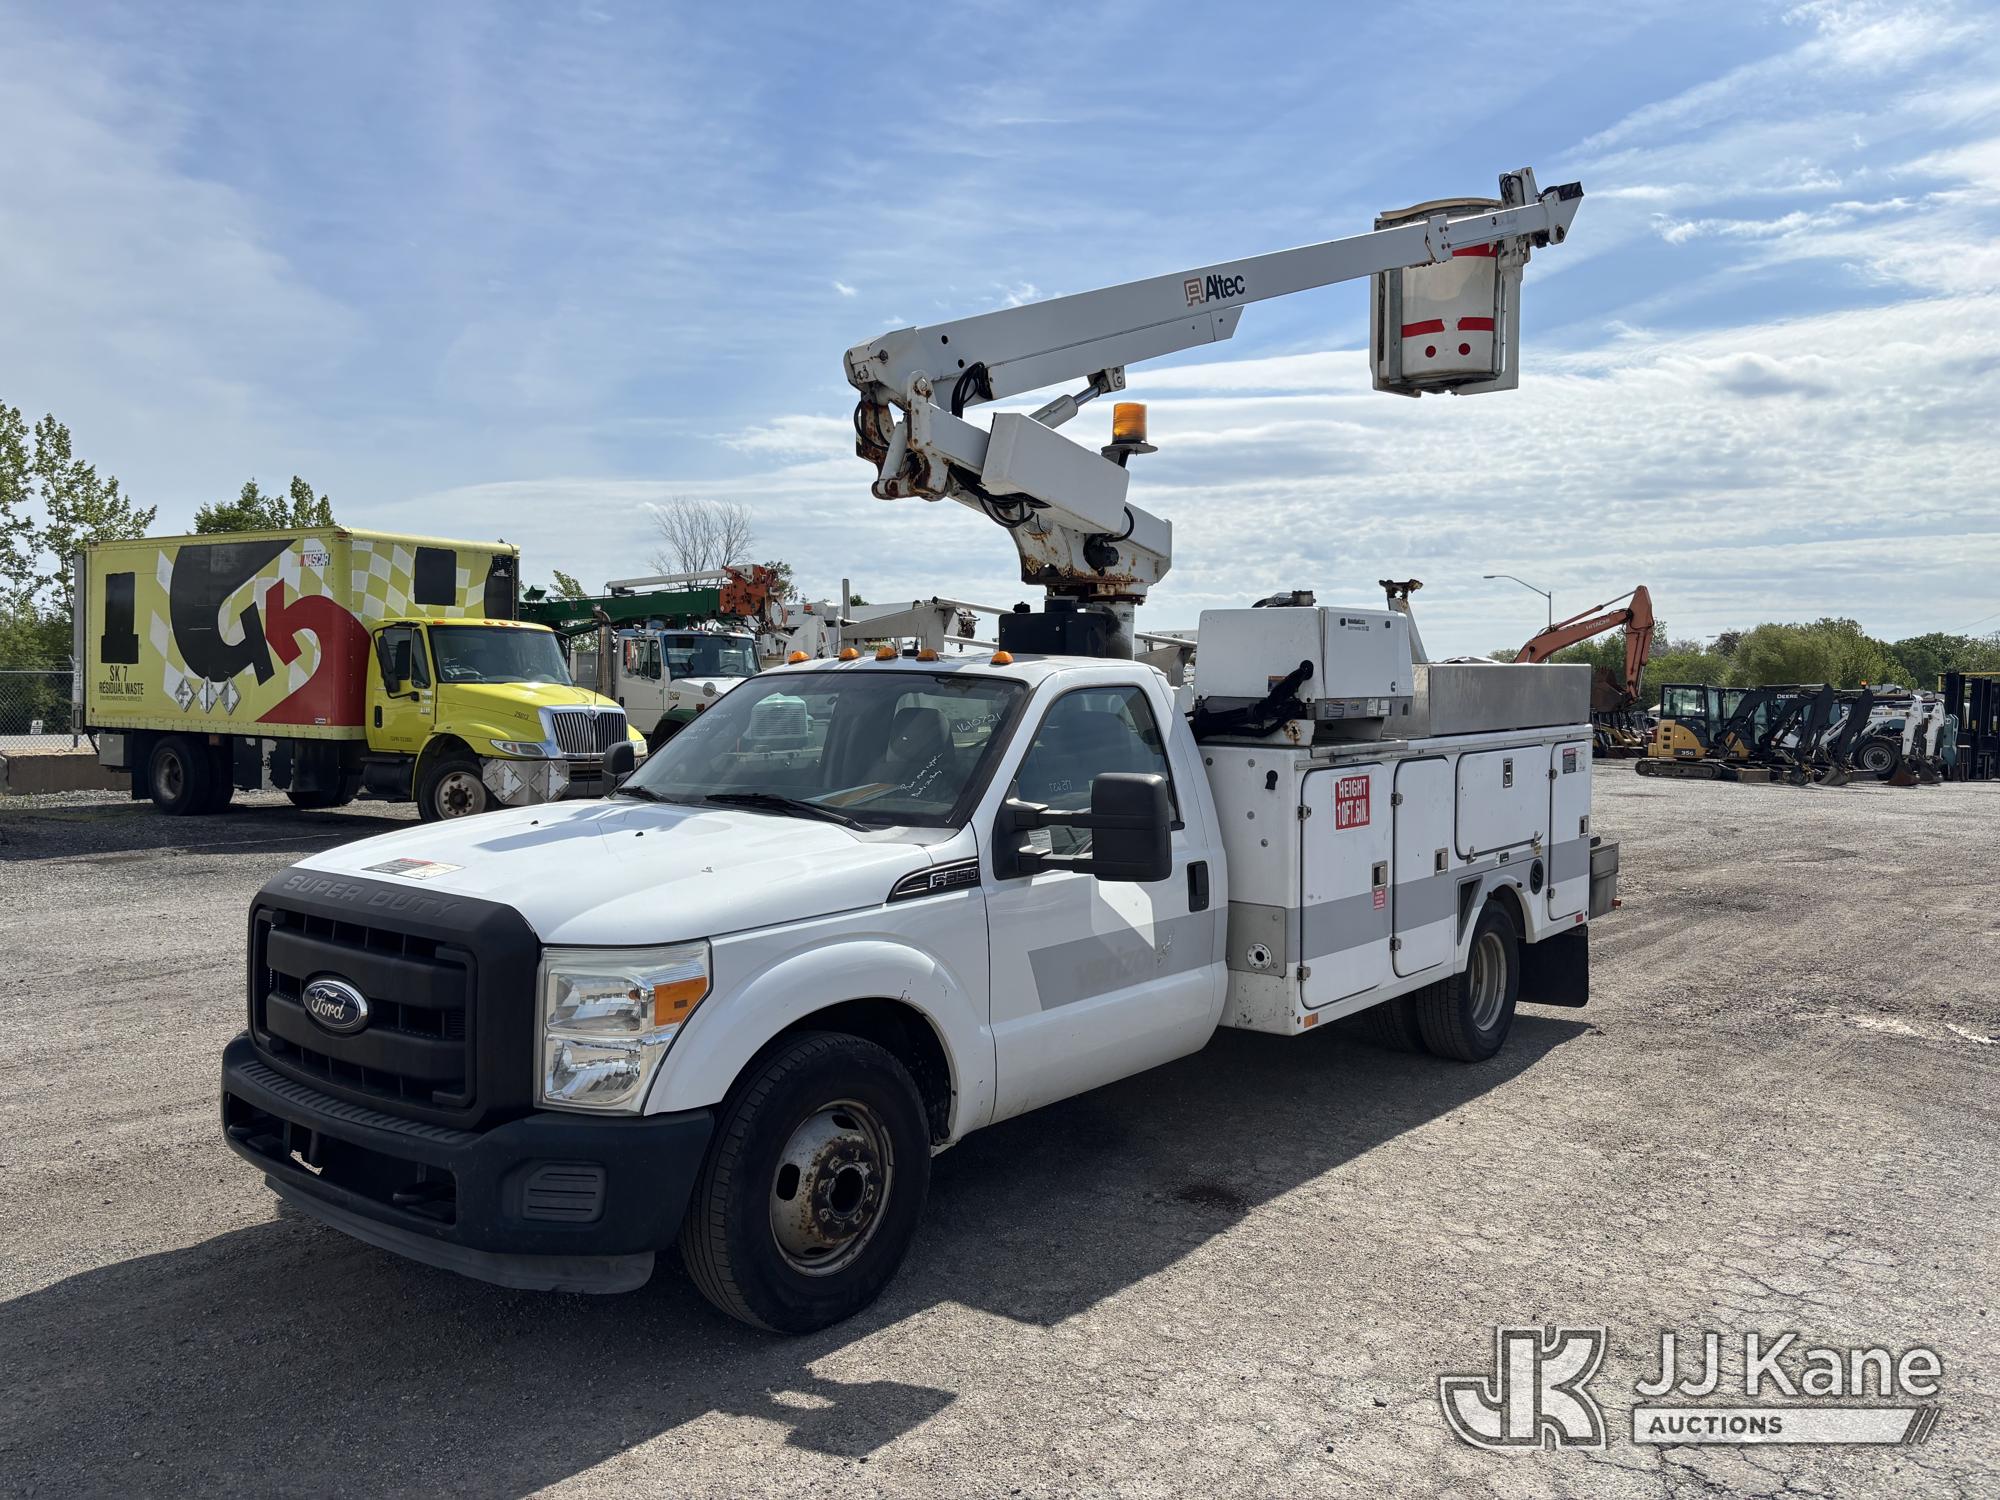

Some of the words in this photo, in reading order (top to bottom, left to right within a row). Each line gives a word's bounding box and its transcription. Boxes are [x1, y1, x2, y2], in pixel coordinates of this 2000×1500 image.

[1205, 274, 1246, 303] Altec
[109, 665, 121, 681] SK
[123, 665, 128, 681] 7
[99, 681, 124, 695] RESIDUAL
[125, 682, 144, 696] WASTE
[1338, 778, 1367, 799] HEIGHT
[282, 875, 366, 901] SUPER
[367, 889, 462, 918] DUTY
[311, 987, 346, 1020] Ford
